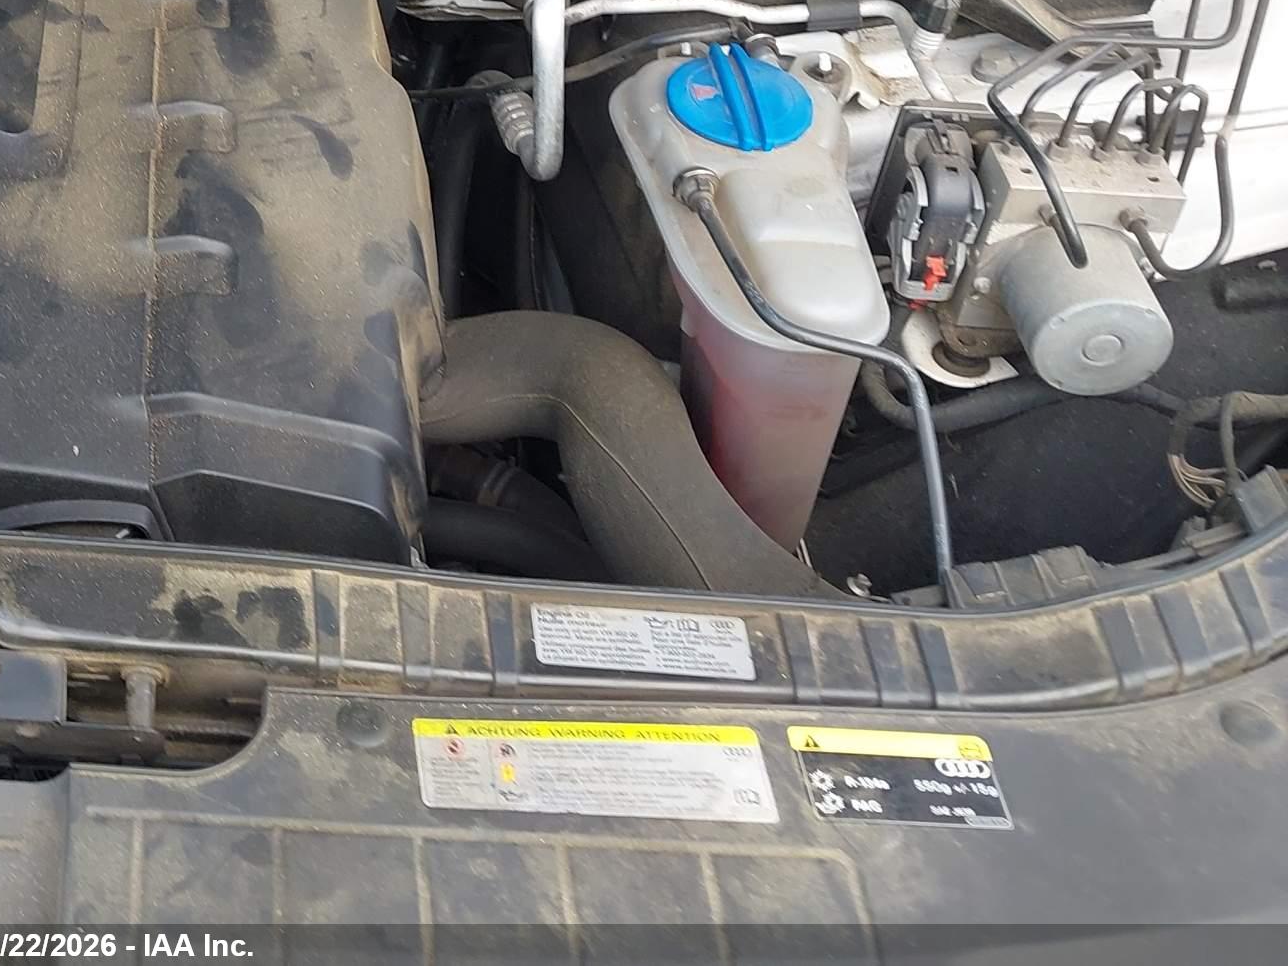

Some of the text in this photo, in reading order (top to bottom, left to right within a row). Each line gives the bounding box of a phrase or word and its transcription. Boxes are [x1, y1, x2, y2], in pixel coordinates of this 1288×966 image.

[468, 726, 721, 743] ACHTUNG WARNING ATTENTION
